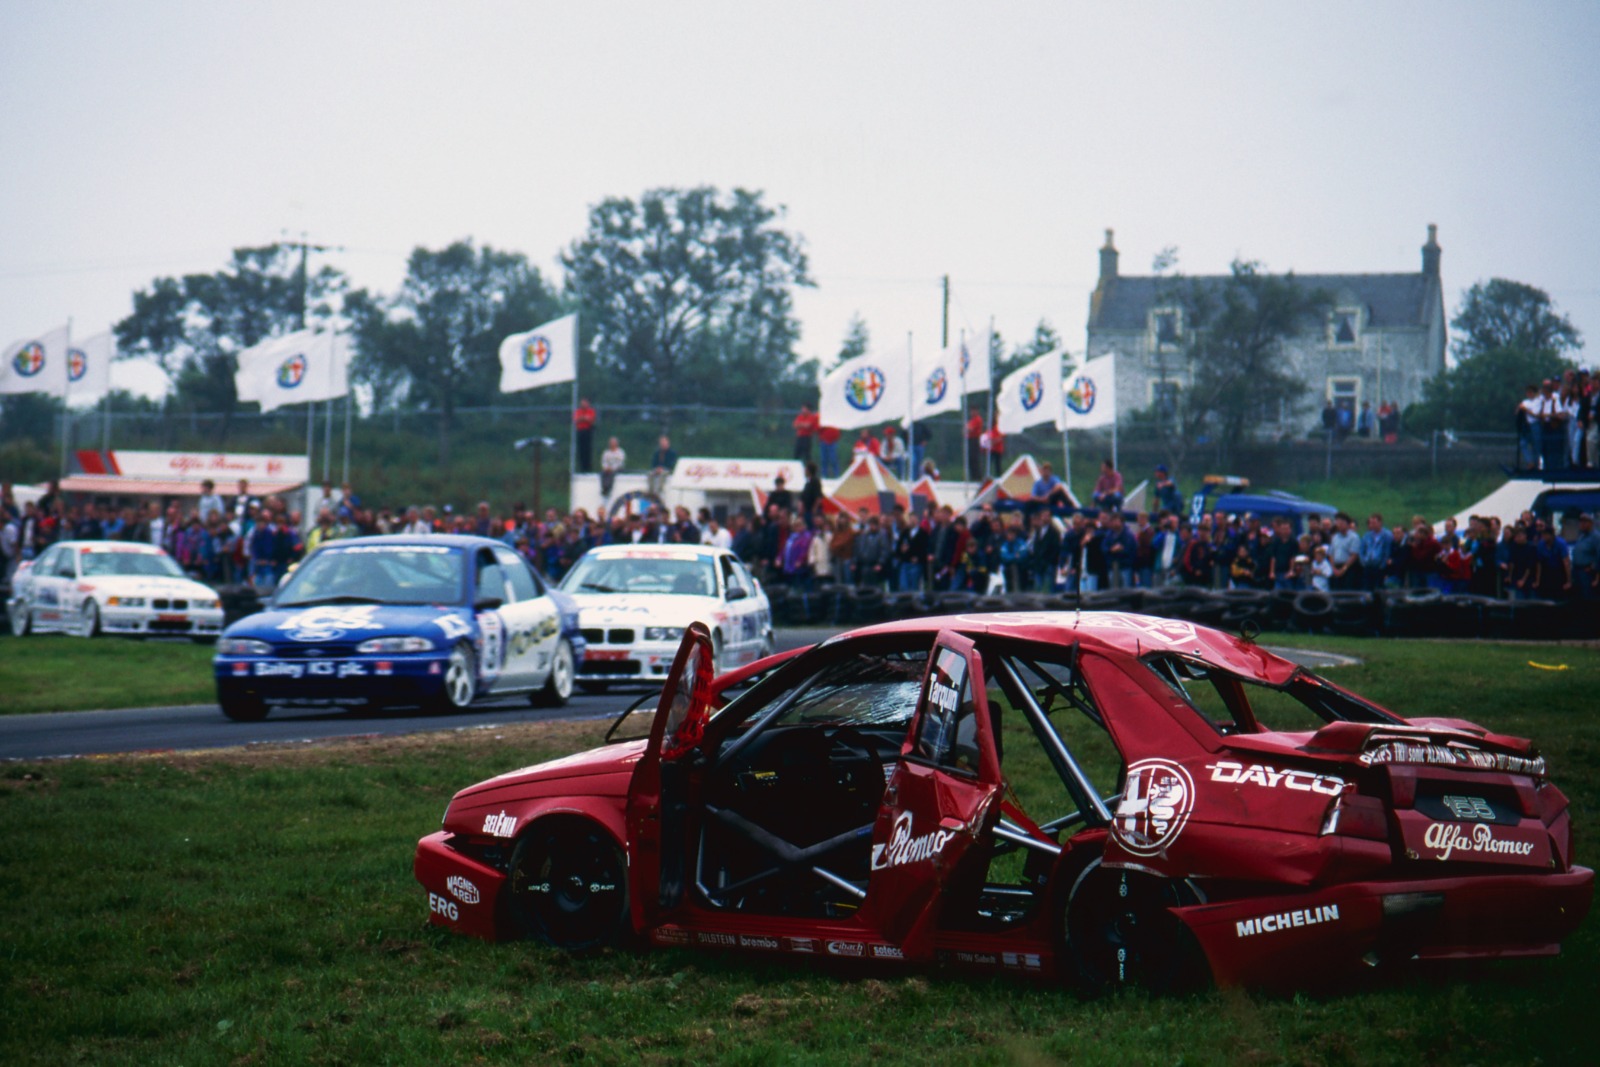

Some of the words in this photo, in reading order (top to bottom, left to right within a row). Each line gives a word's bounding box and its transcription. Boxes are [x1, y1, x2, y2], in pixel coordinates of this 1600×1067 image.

[1206, 761, 1344, 796] DAYCO
[1443, 795, 1496, 820] 155
[889, 810, 955, 867] Romeo
[1424, 822, 1472, 861] Alfa
[1472, 823, 1534, 856] Romeo
[429, 892, 459, 921] ERG
[1236, 904, 1339, 937] MICHELIN
[740, 936, 778, 948] brembo
